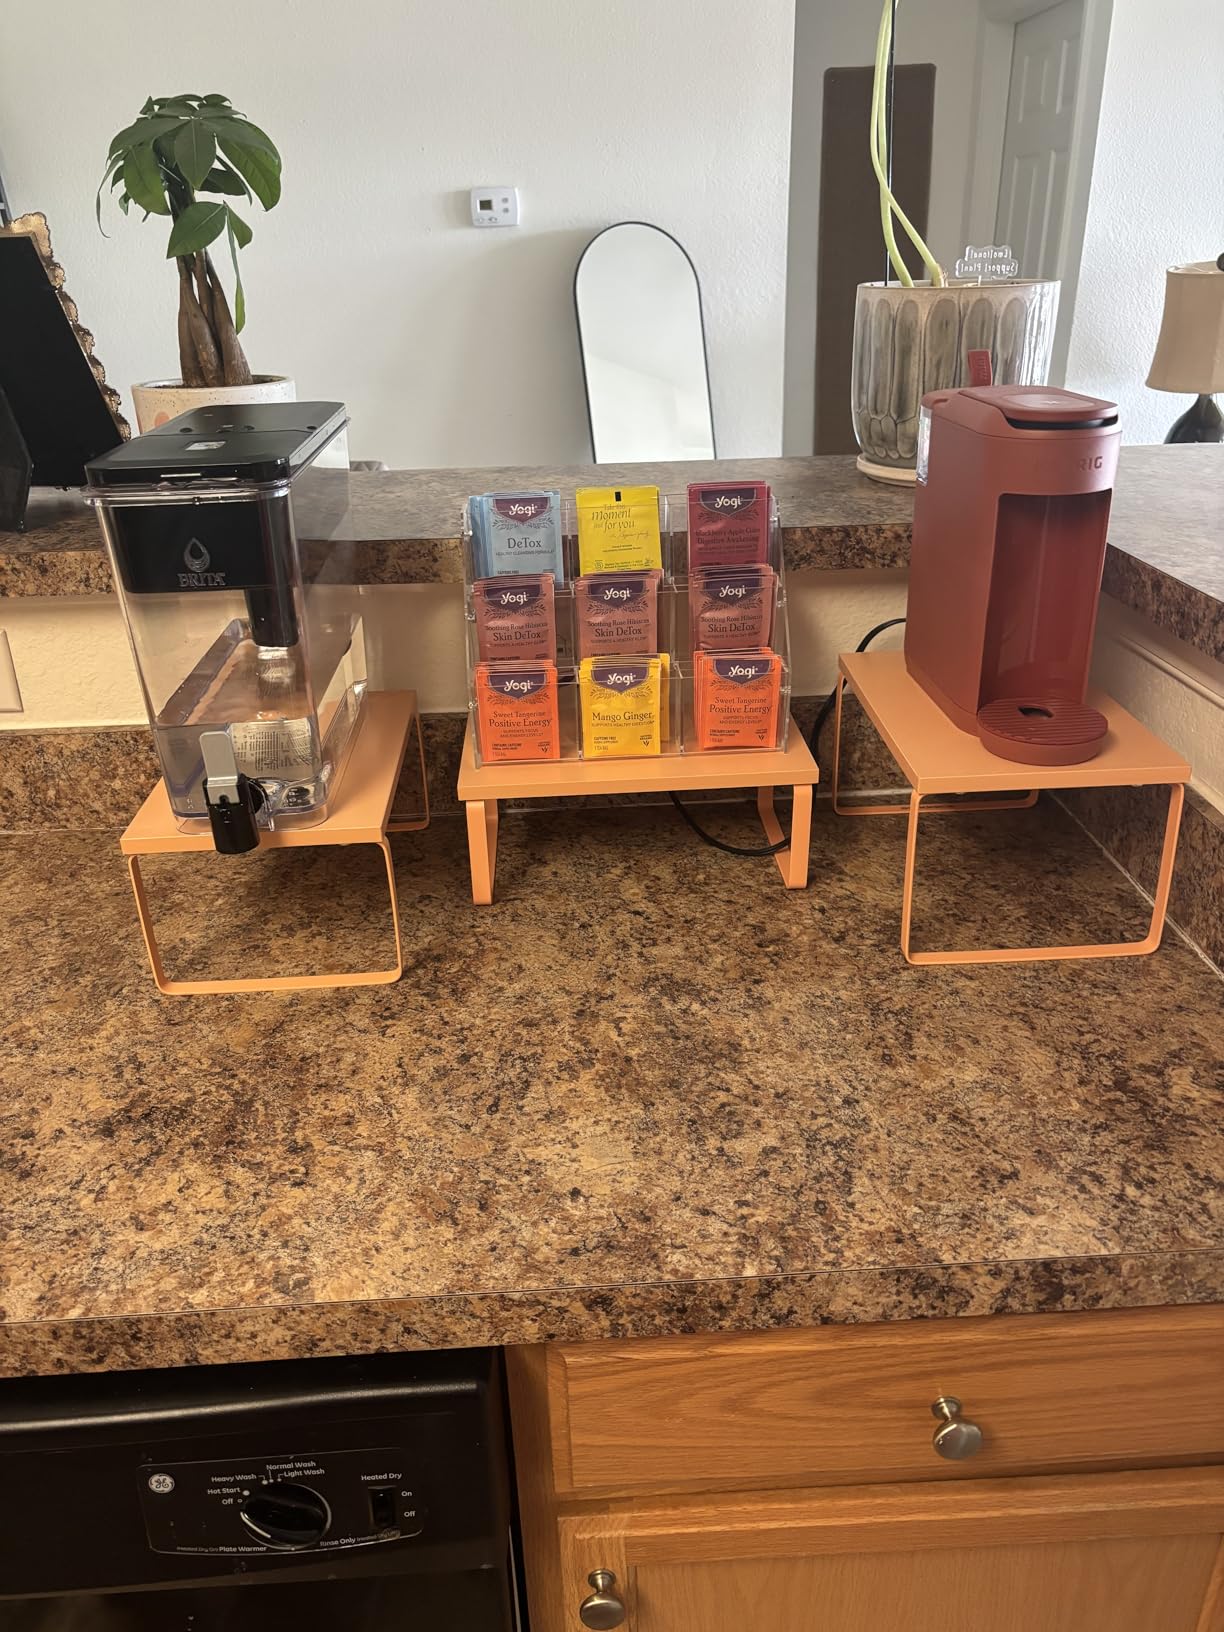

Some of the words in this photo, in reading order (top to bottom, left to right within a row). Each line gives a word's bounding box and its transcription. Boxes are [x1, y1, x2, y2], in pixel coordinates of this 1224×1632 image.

[591, 508, 631, 521] Moment
[604, 519, 616, 533] for
[618, 520, 635, 532] you
[507, 537, 542, 549] DeTox
[177, 572, 226, 588] BRITA
[594, 628, 614, 638] Skin
[616, 626, 642, 636] DeTox
[708, 623, 727, 633] Skin
[729, 622, 756, 632] DeTox
[493, 631, 513, 642] Skin
[514, 630, 541, 640] DeTox
[714, 696, 735, 704] Sweet
[737, 696, 767, 705] Tangerine
[493, 710, 513, 719] Sweet
[709, 703, 741, 714] Positive
[743, 704, 771, 715] Energy
[592, 712, 621, 723] Mango
[623, 711, 652, 722] Ginger
[489, 718, 521, 728] Positive
[523, 718, 551, 728] Energy
[266, 1462, 293, 1471] Normal
[294, 1460, 316, 1469] Wash
[283, 1469, 303, 1478] Light
[303, 1467, 325, 1476] Wash
[361, 1473, 388, 1481] Heated
[388, 1472, 403, 1480] Dry
[211, 1475, 234, 1484] Heavy
[235, 1473, 257, 1481] Wash
[207, 1487, 222, 1495] Hot
[221, 1486, 241, 1495] Start
[403, 1510, 416, 1518] Off
[339, 1536, 356, 1545] Only
